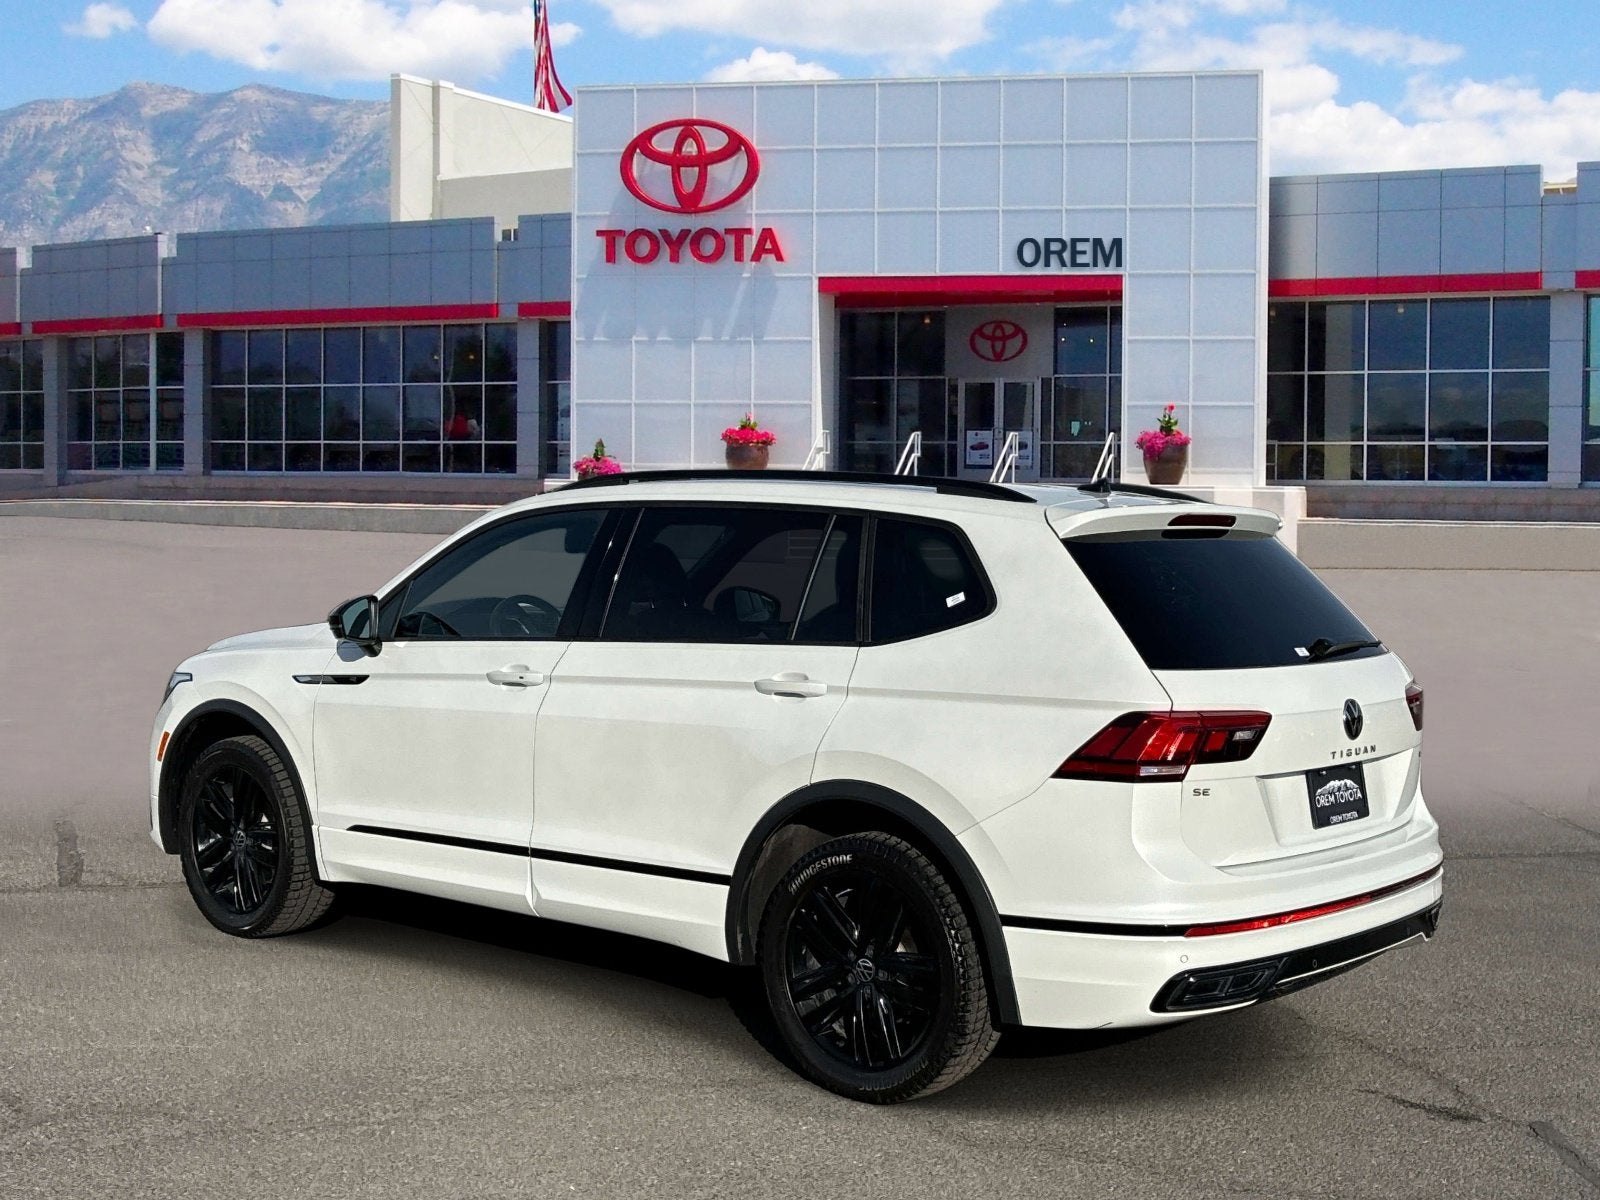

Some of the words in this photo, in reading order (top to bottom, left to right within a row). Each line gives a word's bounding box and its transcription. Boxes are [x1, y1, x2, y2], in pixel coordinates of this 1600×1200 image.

[596, 227, 785, 265] TOYOTA
[1016, 237, 1123, 268] OREM
[1330, 745, 1376, 760] TIGUAN
[1192, 788, 1211, 797] SE
[1315, 793, 1335, 808] OREM
[1335, 788, 1362, 804] TOYOTA
[788, 853, 853, 896] BRIDGESTONE
